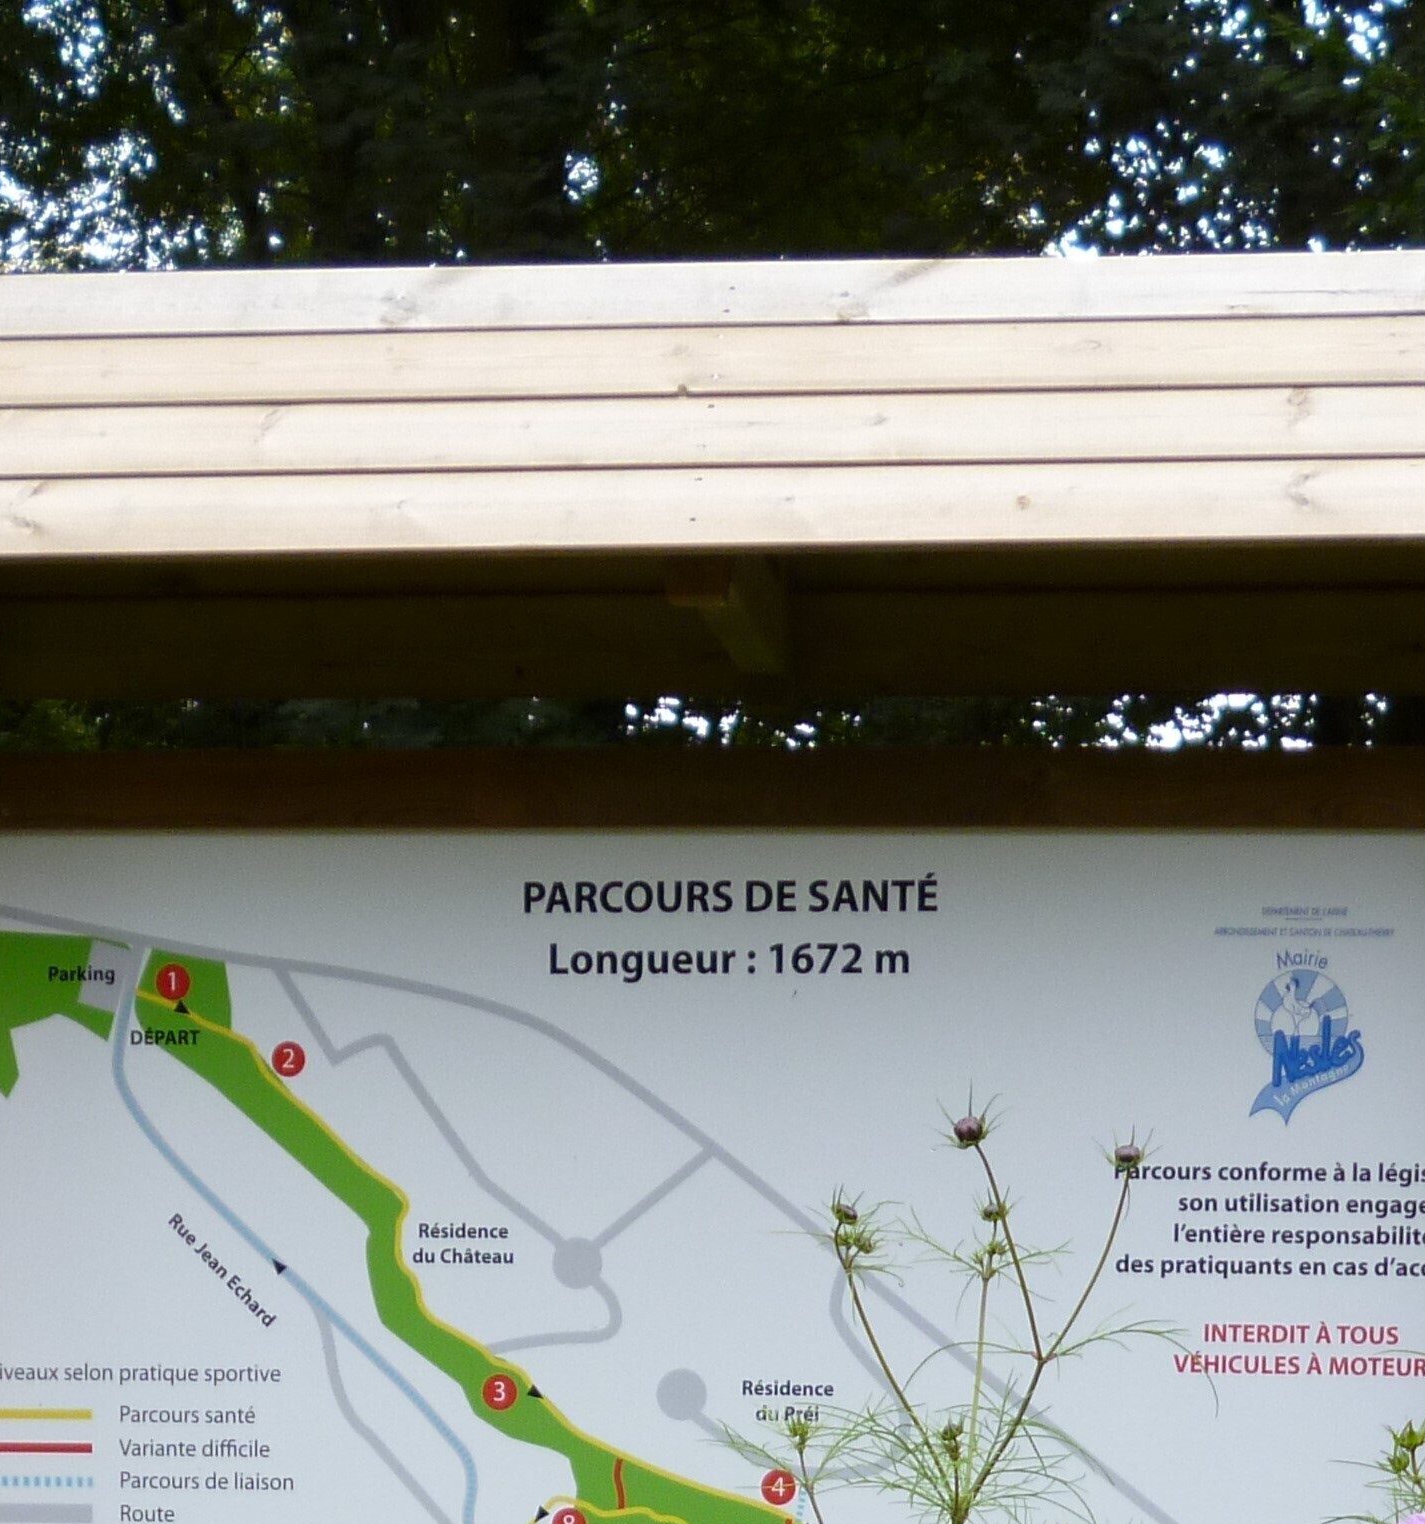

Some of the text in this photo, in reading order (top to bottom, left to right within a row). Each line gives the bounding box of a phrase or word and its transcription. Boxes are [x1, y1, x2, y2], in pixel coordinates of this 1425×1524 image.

[523, 872, 938, 914] PARCOURS DE SANTÉ
[549, 943, 910, 984] Longueur : 1672 m
[1276, 948, 1329, 970] Mairie
[48, 966, 116, 985] Parking
[168, 972, 177, 991] 1
[130, 1027, 200, 1045] DÉPART
[282, 1049, 295, 1069] 2
[1272, 1014, 1362, 1088] Nesles
[1114, 1162, 1212, 1181] Parcours
[1217, 1162, 1328, 1182] conforme
[1333, 1163, 1346, 1182] à
[1352, 1163, 1371, 1182] la
[1178, 1197, 1218, 1212] son
[1224, 1193, 1340, 1213] utilisation
[418, 1222, 509, 1239] Résidence
[1173, 1222, 1266, 1243] l'entière
[412, 1247, 514, 1265] du Château
[168, 1213, 277, 1327] Rue Jean Echard
[1115, 1254, 1154, 1274] des
[1160, 1255, 1293, 1280] pratiquants
[1298, 1260, 1326, 1276] en
[1332, 1261, 1368, 1276] cas
[1204, 1321, 1399, 1345] INTERDIT À TOUS
[1173, 1351, 1301, 1375] VÉHICULES
[1306, 1350, 1323, 1375] À
[64, 1363, 114, 1382] selon
[119, 1364, 199, 1387] pratique
[204, 1366, 281, 1387] sportive
[493, 1381, 506, 1401] 3
[742, 1379, 834, 1397] Résidence
[119, 1405, 256, 1424] Parcours santé
[755, 1404, 779, 1421] du
[119, 1438, 271, 1458] Variante difficile
[119, 1470, 294, 1491] Parcours de liaison
[771, 1476, 786, 1498] 4
[120, 1504, 175, 1523] Route
